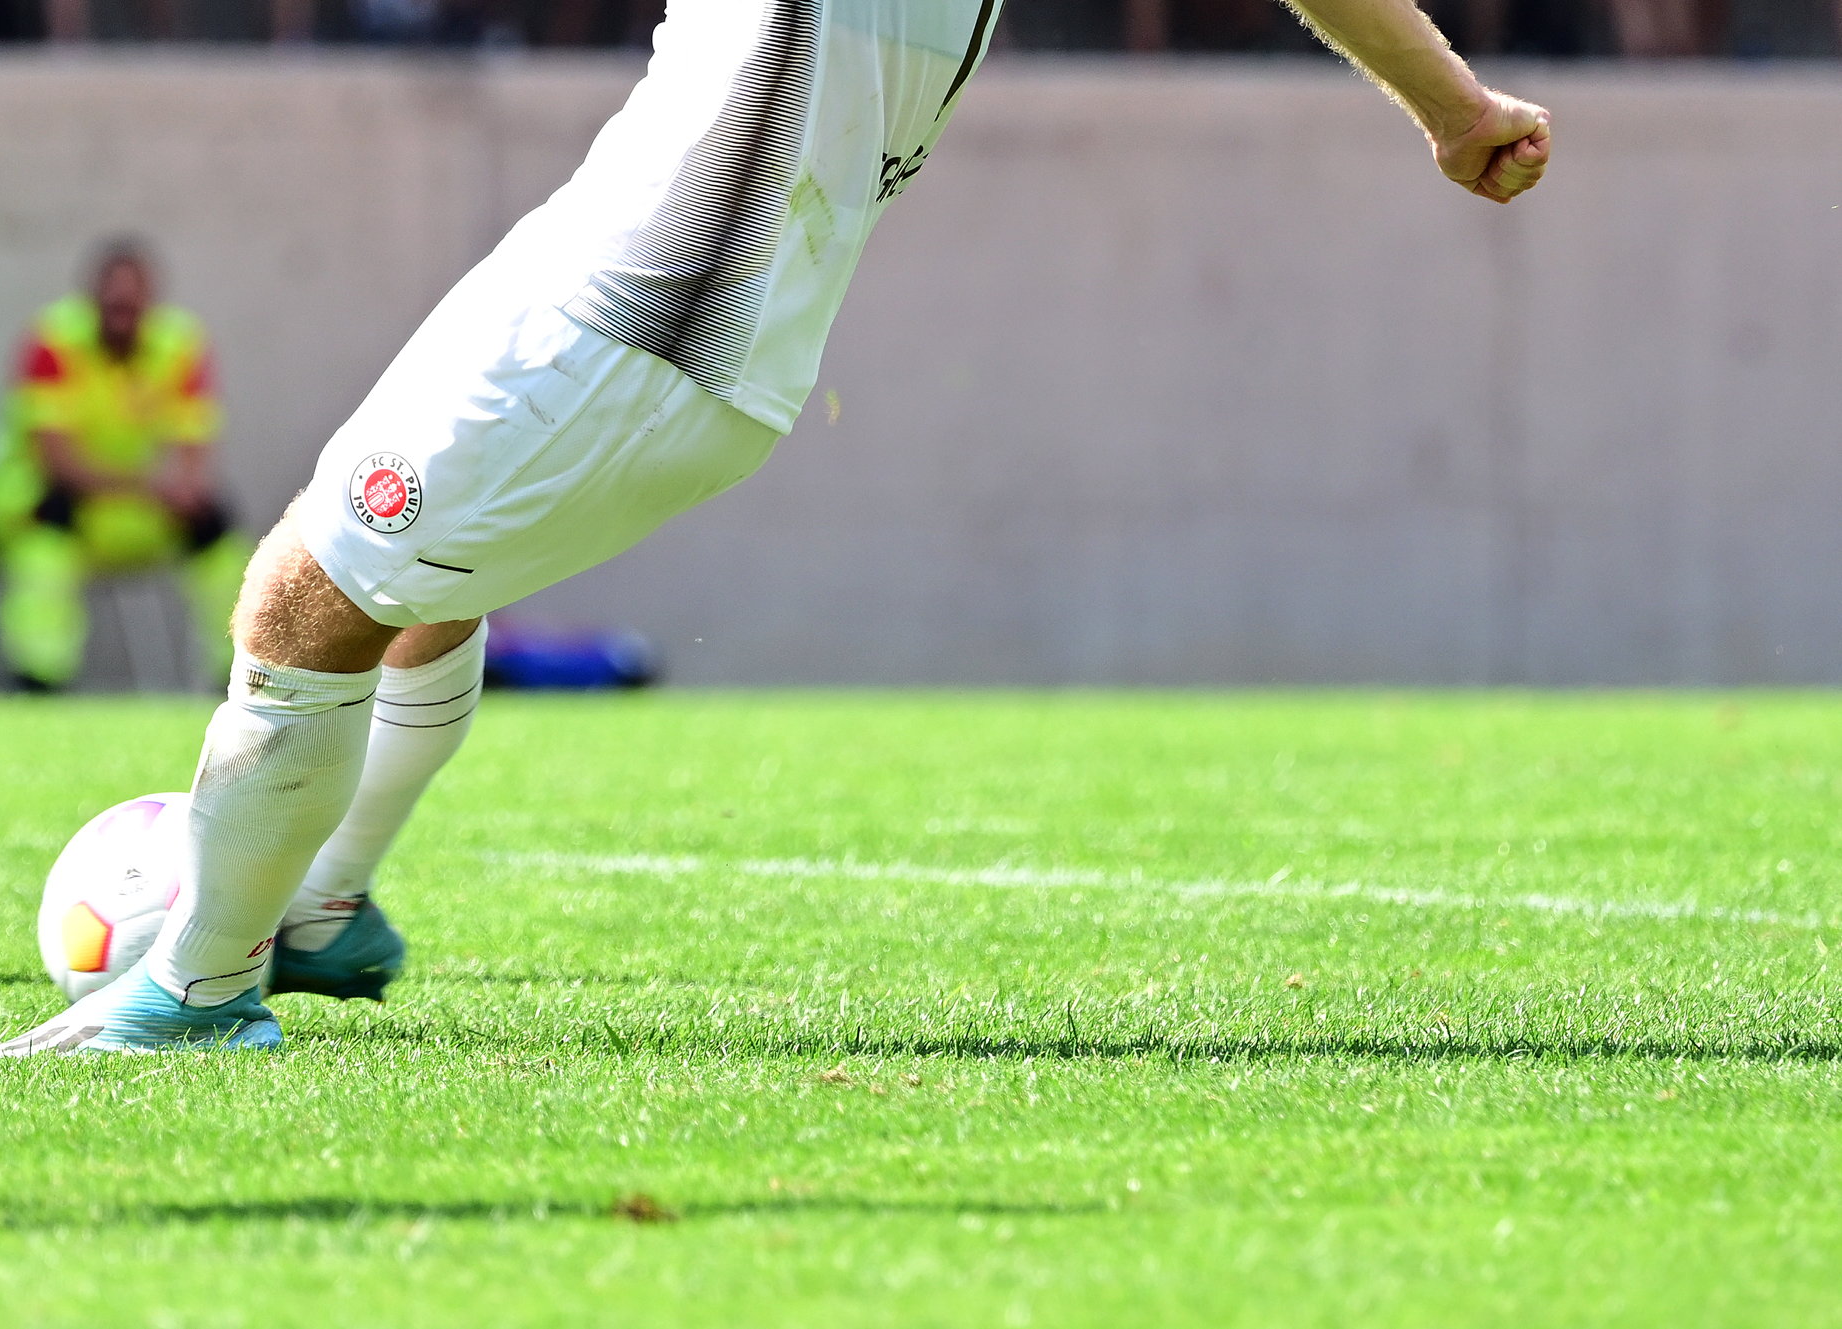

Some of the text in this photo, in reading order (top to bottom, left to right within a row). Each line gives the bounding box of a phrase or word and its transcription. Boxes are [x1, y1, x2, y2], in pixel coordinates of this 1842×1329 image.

[354, 496, 374, 524] 1910
[372, 456, 384, 468] FC
[401, 476, 418, 522] PAULI
